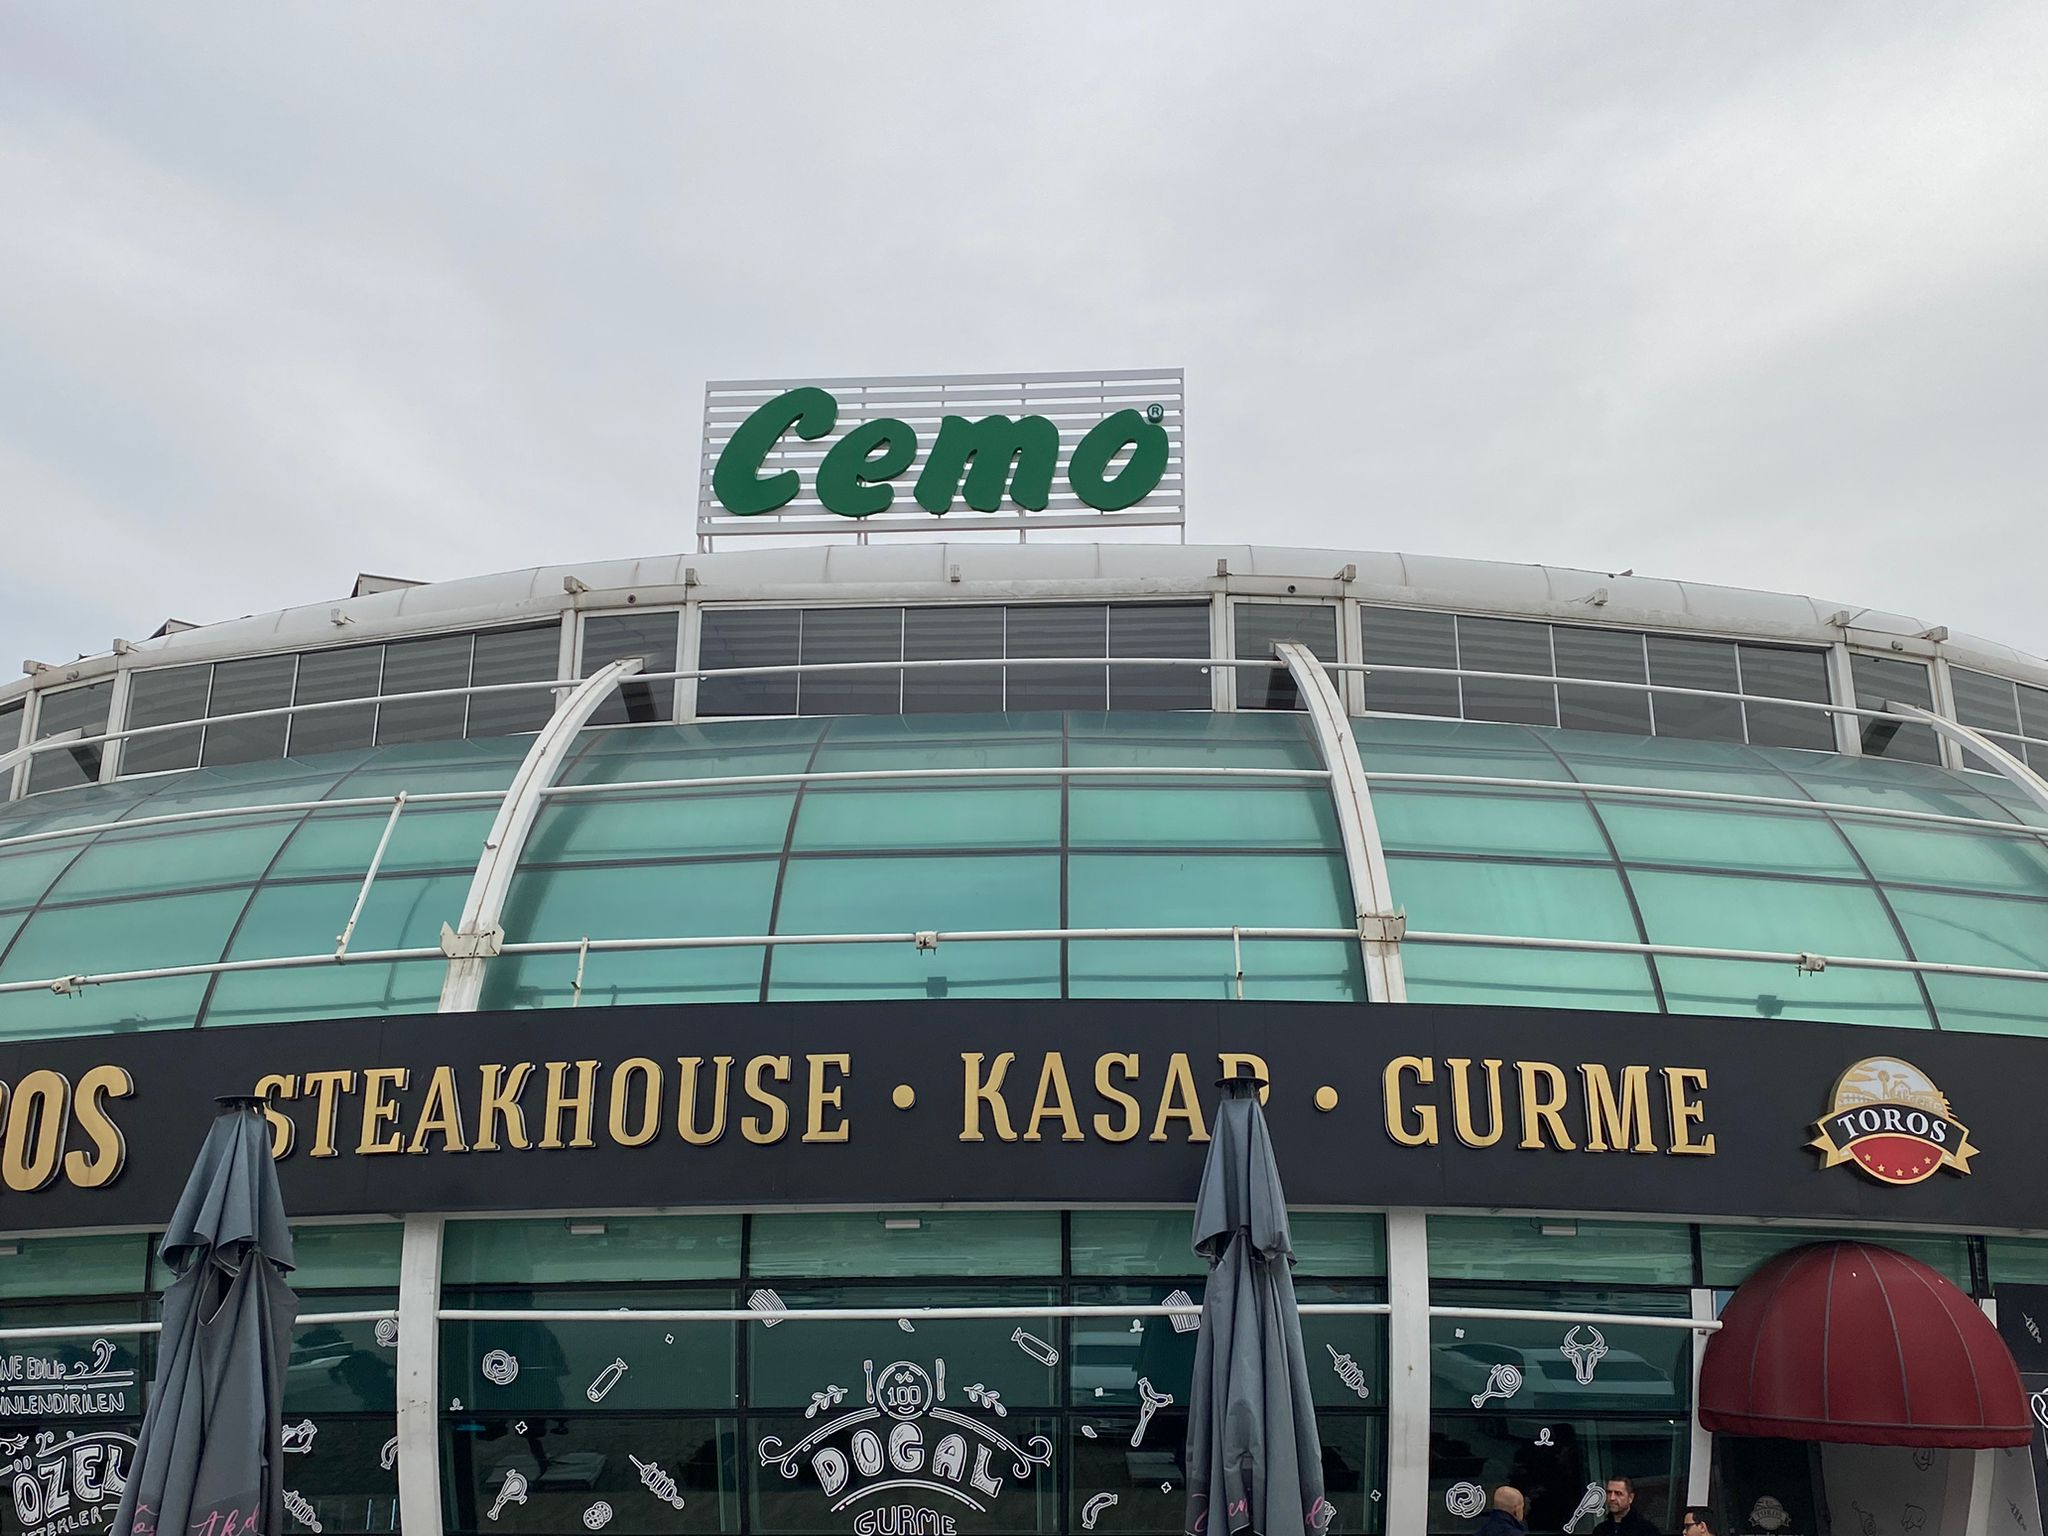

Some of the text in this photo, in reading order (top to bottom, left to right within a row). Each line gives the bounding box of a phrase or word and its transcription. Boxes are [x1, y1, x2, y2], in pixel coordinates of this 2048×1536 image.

[713, 386, 1169, 516] Cemo
[253, 1054, 851, 1161] STEAKHOUSE
[1382, 1056, 1716, 1154] GURME
[1836, 1107, 1948, 1143] TOROS
[0, 1065, 134, 1192] OS
[0, 1355, 24, 1382] NE
[0, 1391, 125, 1415] INLENDIRILEN
[887, 1385, 922, 1406] 100
[13, 1444, 128, 1526] ÖZEL
[853, 1504, 957, 1536] GURME
